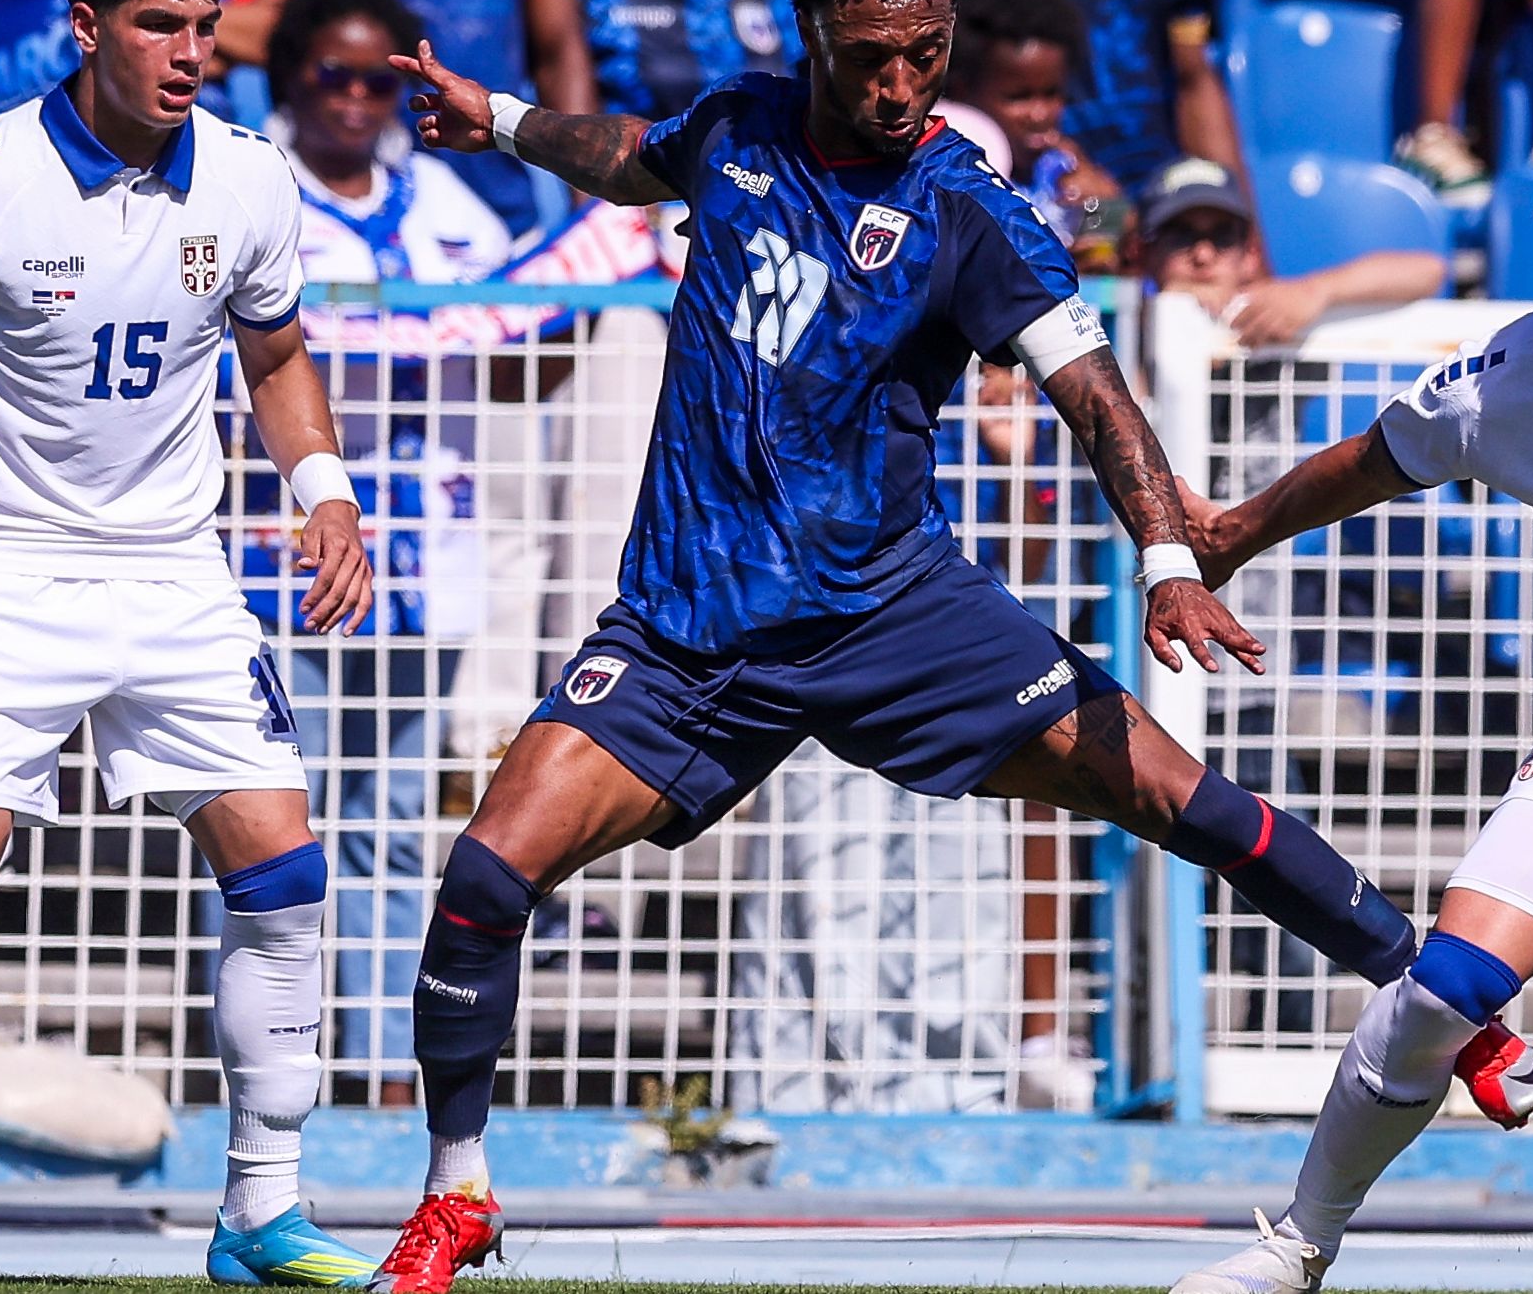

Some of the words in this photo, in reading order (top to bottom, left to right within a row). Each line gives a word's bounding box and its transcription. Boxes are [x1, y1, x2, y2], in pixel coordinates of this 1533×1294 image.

[722, 162, 775, 193] capelli
[738, 182, 767, 198] SPORT
[866, 208, 906, 224] FCF
[22, 256, 85, 276] capelli
[84, 321, 169, 400] 15
[1016, 658, 1077, 706] capelli
